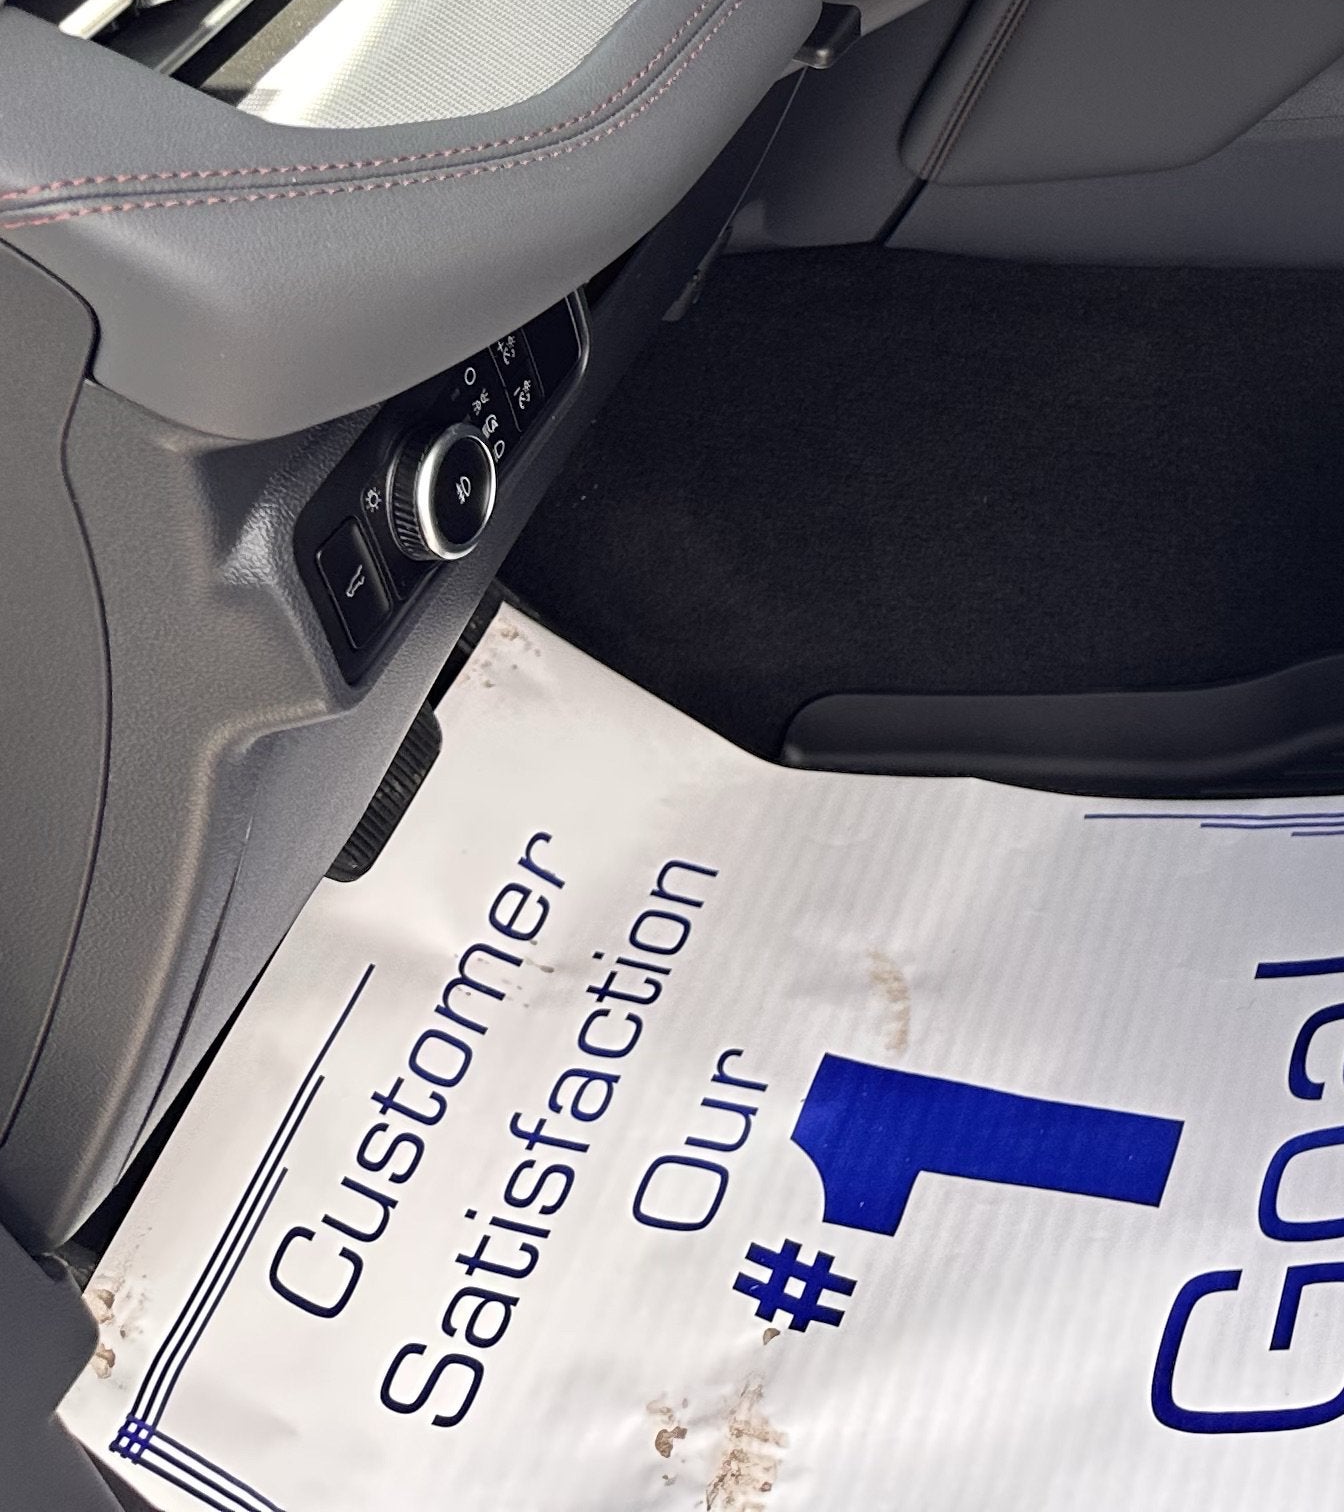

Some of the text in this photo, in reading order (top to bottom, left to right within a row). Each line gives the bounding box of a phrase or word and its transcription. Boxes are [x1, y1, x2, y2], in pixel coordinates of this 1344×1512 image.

[269, 829, 570, 1323] Customer
[381, 856, 720, 1428] Satisfaction
[631, 1045, 769, 1233] Our
[732, 1053, 1185, 1332] #1
